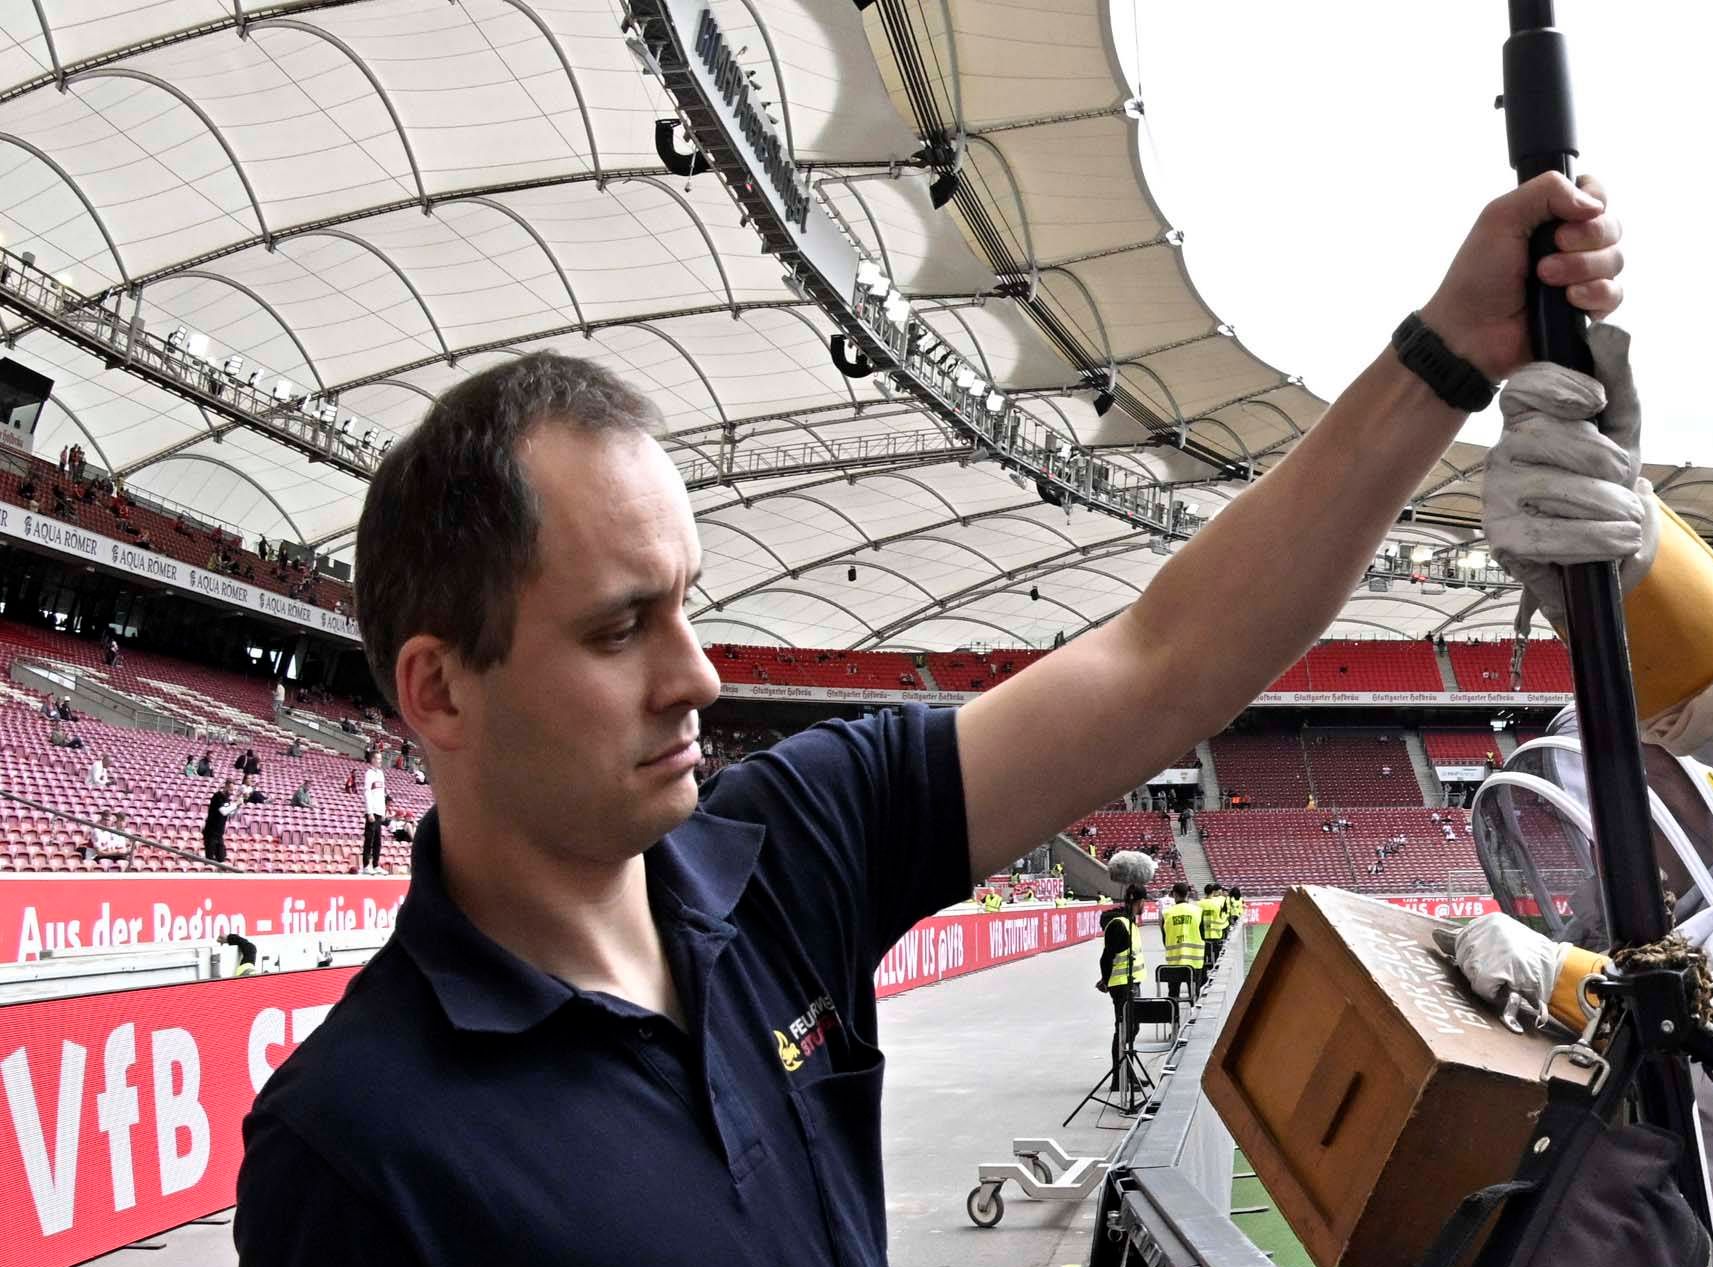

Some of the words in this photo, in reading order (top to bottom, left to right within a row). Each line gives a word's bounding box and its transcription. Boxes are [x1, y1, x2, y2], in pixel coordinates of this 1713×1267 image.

[33, 521, 62, 546] AQUA
[64, 529, 98, 555] RÖMER
[119, 550, 146, 570] AQUA
[147, 557, 177, 580] RÖMER
[197, 575, 220, 595] AQUA
[266, 597, 287, 615] AQUA
[1434, 902, 1484, 918] @VfB
[17, 906, 81, 962] Aus
[92, 902, 142, 947] der
[153, 898, 246, 945] Region
[282, 896, 319, 936] für
[324, 895, 356, 932] die
[1004, 916, 1039, 957] STUTTGART
[922, 927, 936, 976] US
[1, 1022, 211, 1238] VfB
